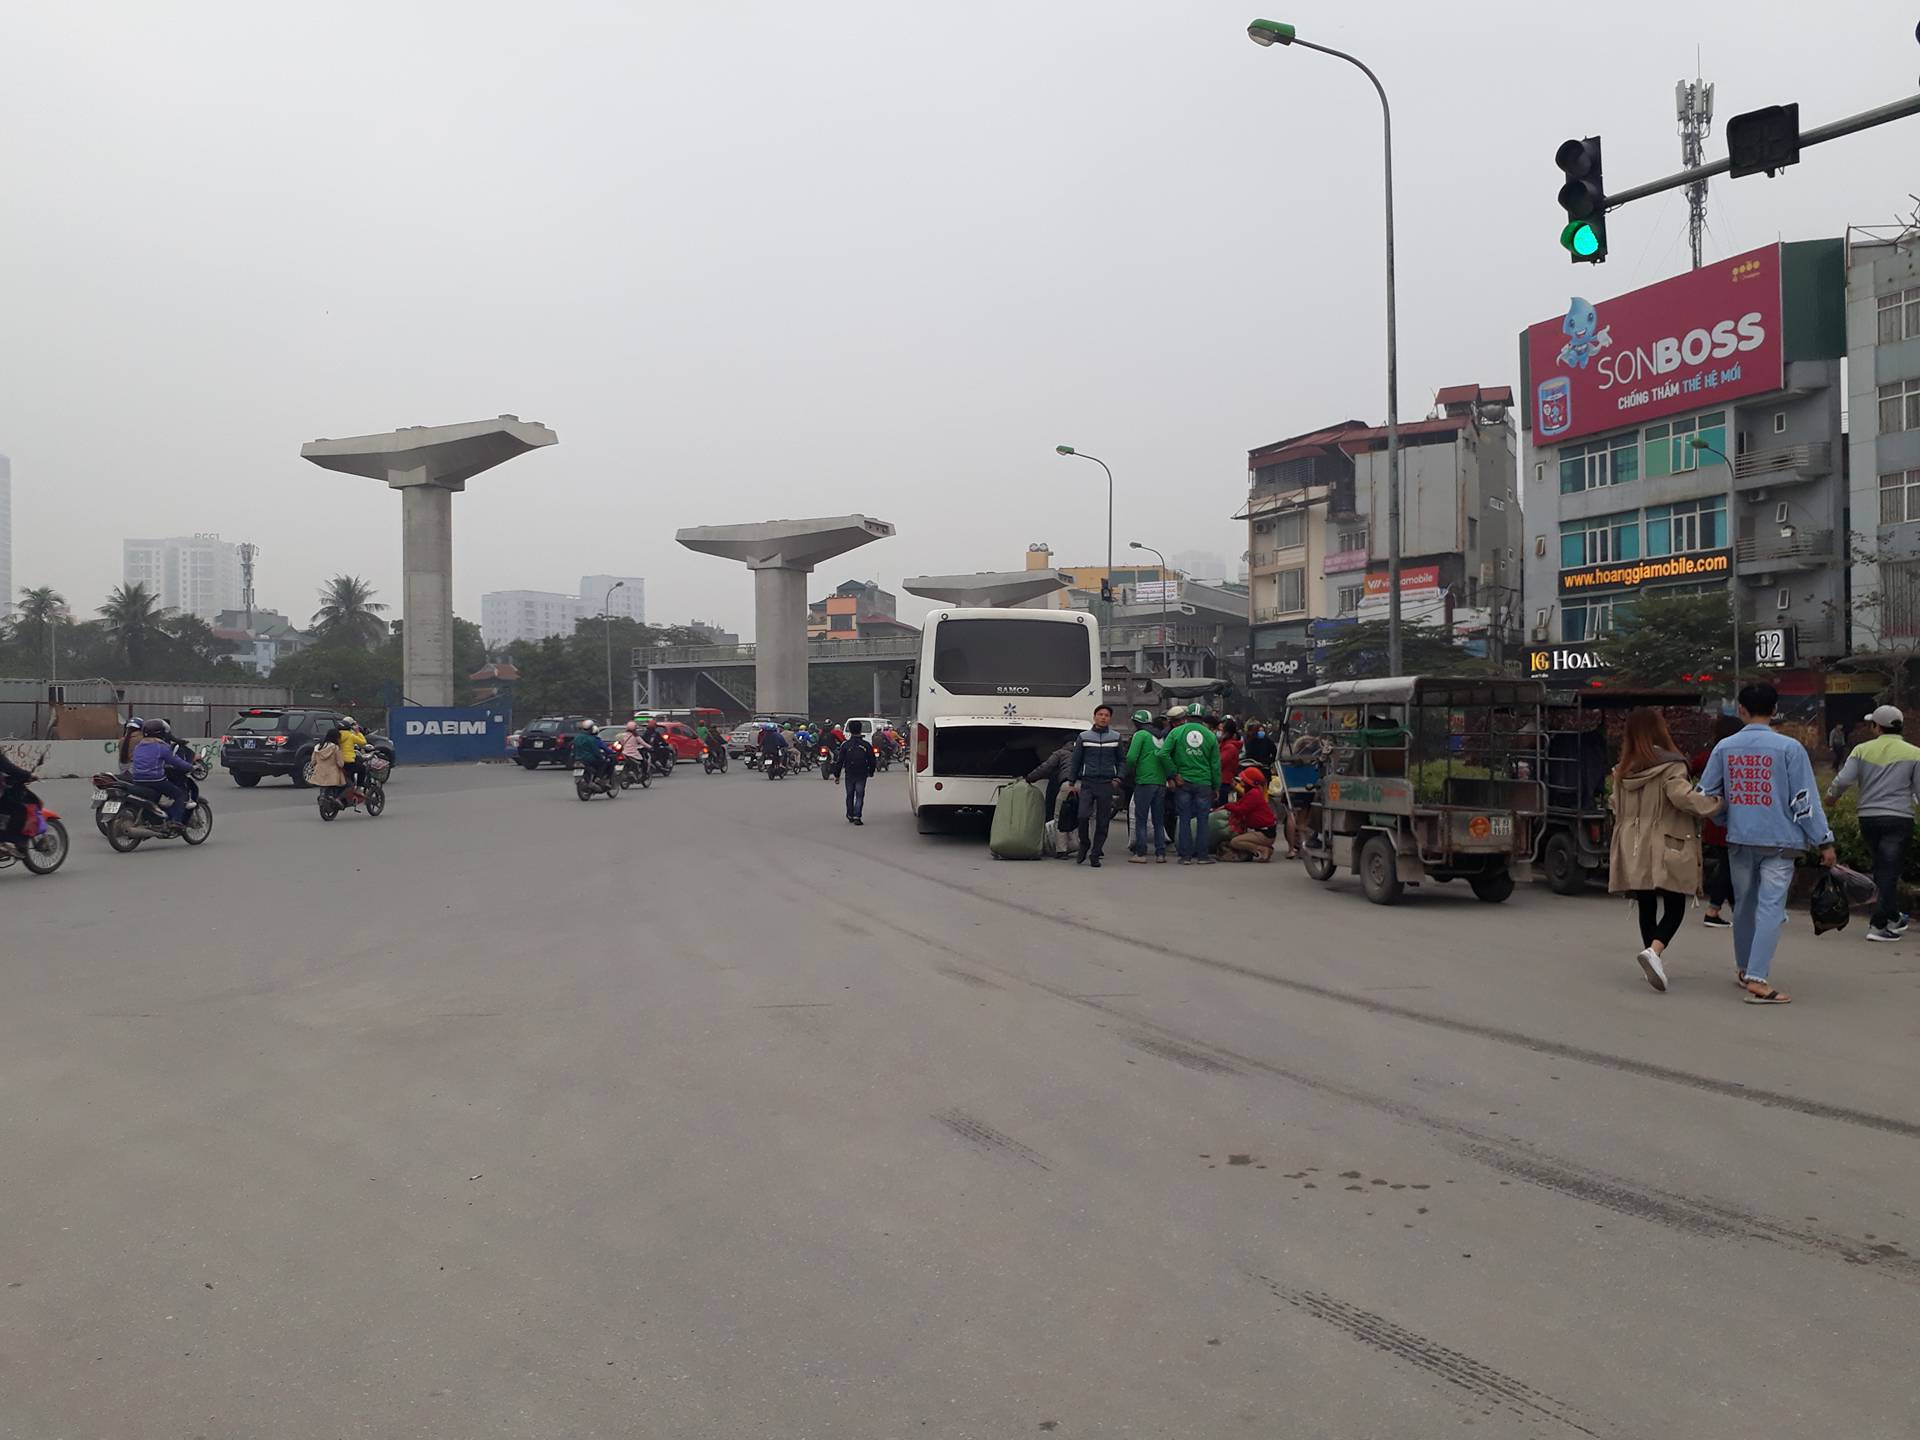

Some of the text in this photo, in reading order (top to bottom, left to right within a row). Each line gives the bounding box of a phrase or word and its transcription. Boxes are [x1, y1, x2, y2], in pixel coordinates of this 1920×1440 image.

[1617, 361, 1742, 410] CHỐNG THẤM THẾ HỆ MỚI
[1564, 555, 1728, 585] www.hoanggiamobile.com
[1759, 633, 1781, 659] 02
[1553, 650, 1615, 670] HOAN
[996, 686, 1030, 695] SAMCO
